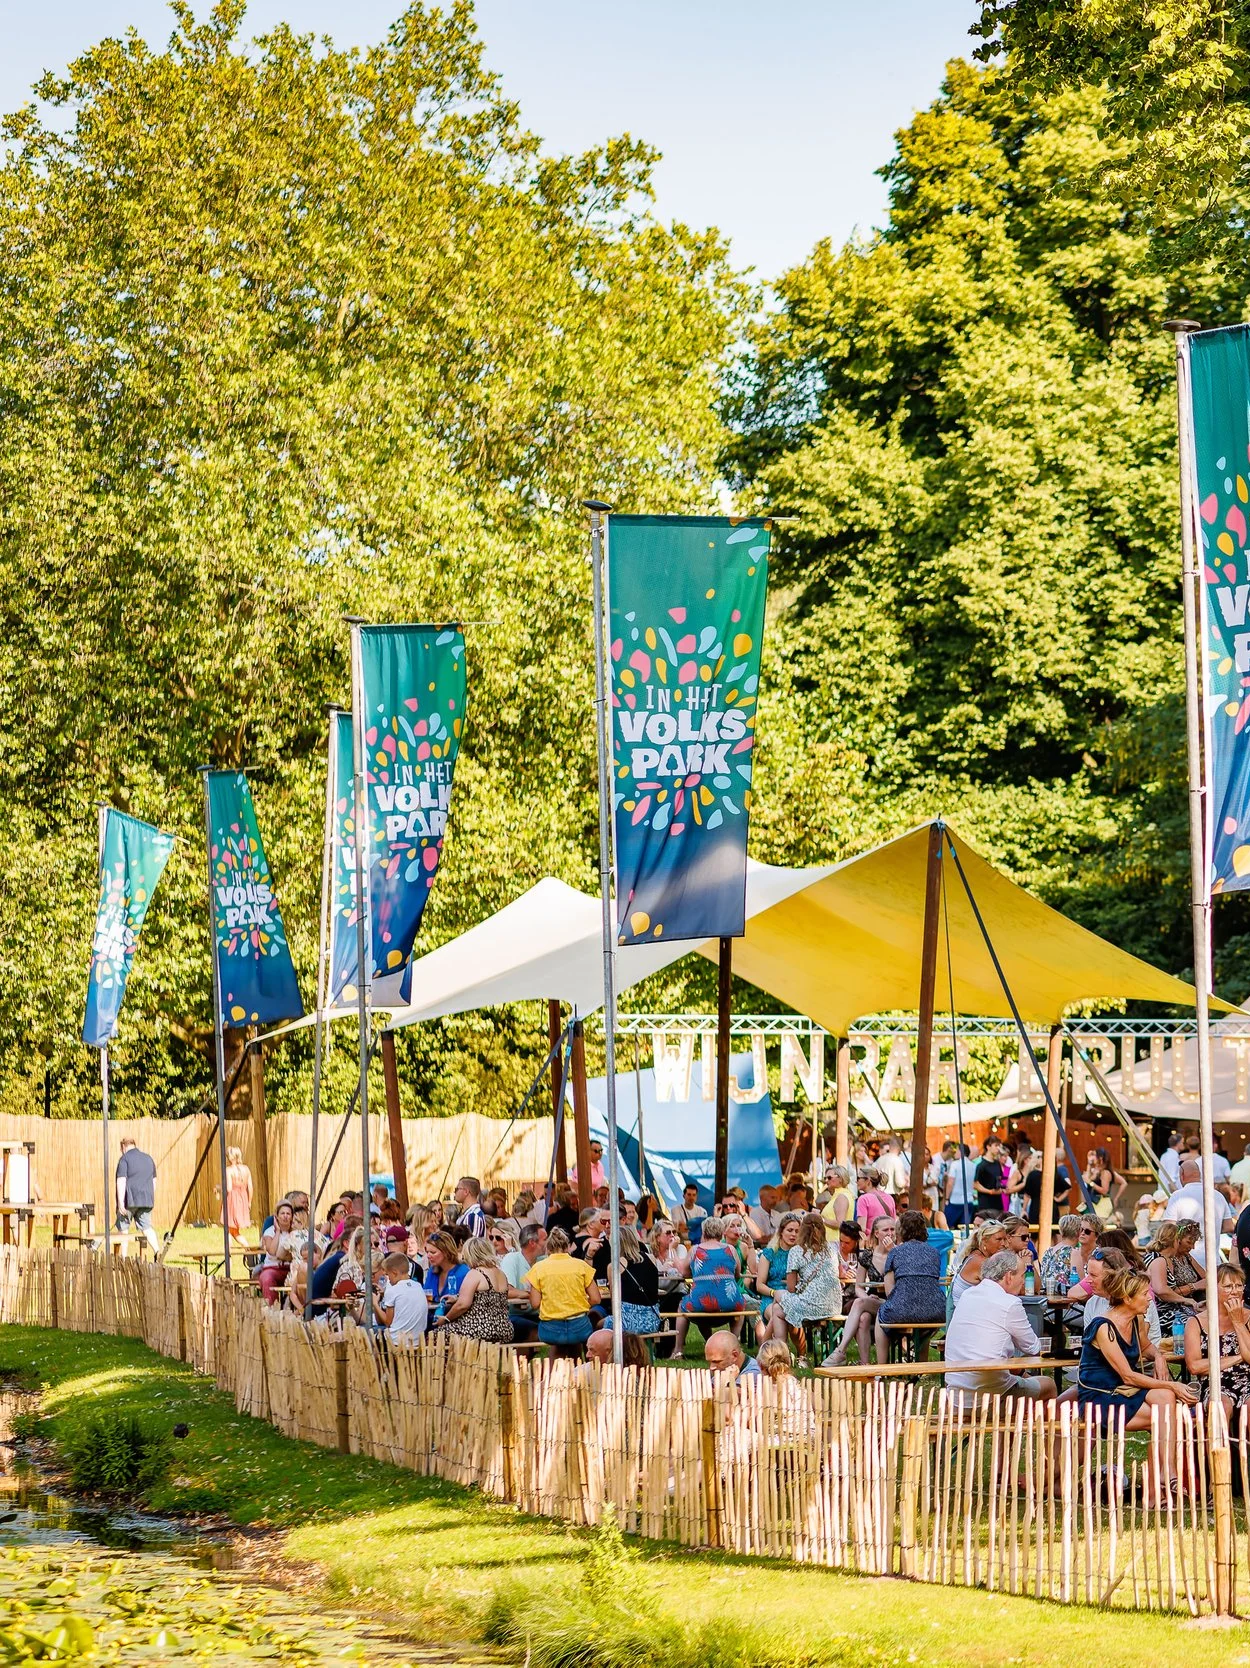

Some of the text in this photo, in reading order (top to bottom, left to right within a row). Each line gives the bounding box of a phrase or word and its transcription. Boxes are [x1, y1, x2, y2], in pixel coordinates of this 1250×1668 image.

[645, 684, 671, 713] IN
[617, 708, 747, 745] VOLKS
[393, 760, 452, 786] IN HET
[630, 742, 732, 779] PARK
[373, 780, 453, 813] VOLK
[385, 809, 448, 841] PAR
[231, 869, 242, 887] IN
[216, 882, 272, 907] VOLS
[96, 914, 134, 947] LKS
